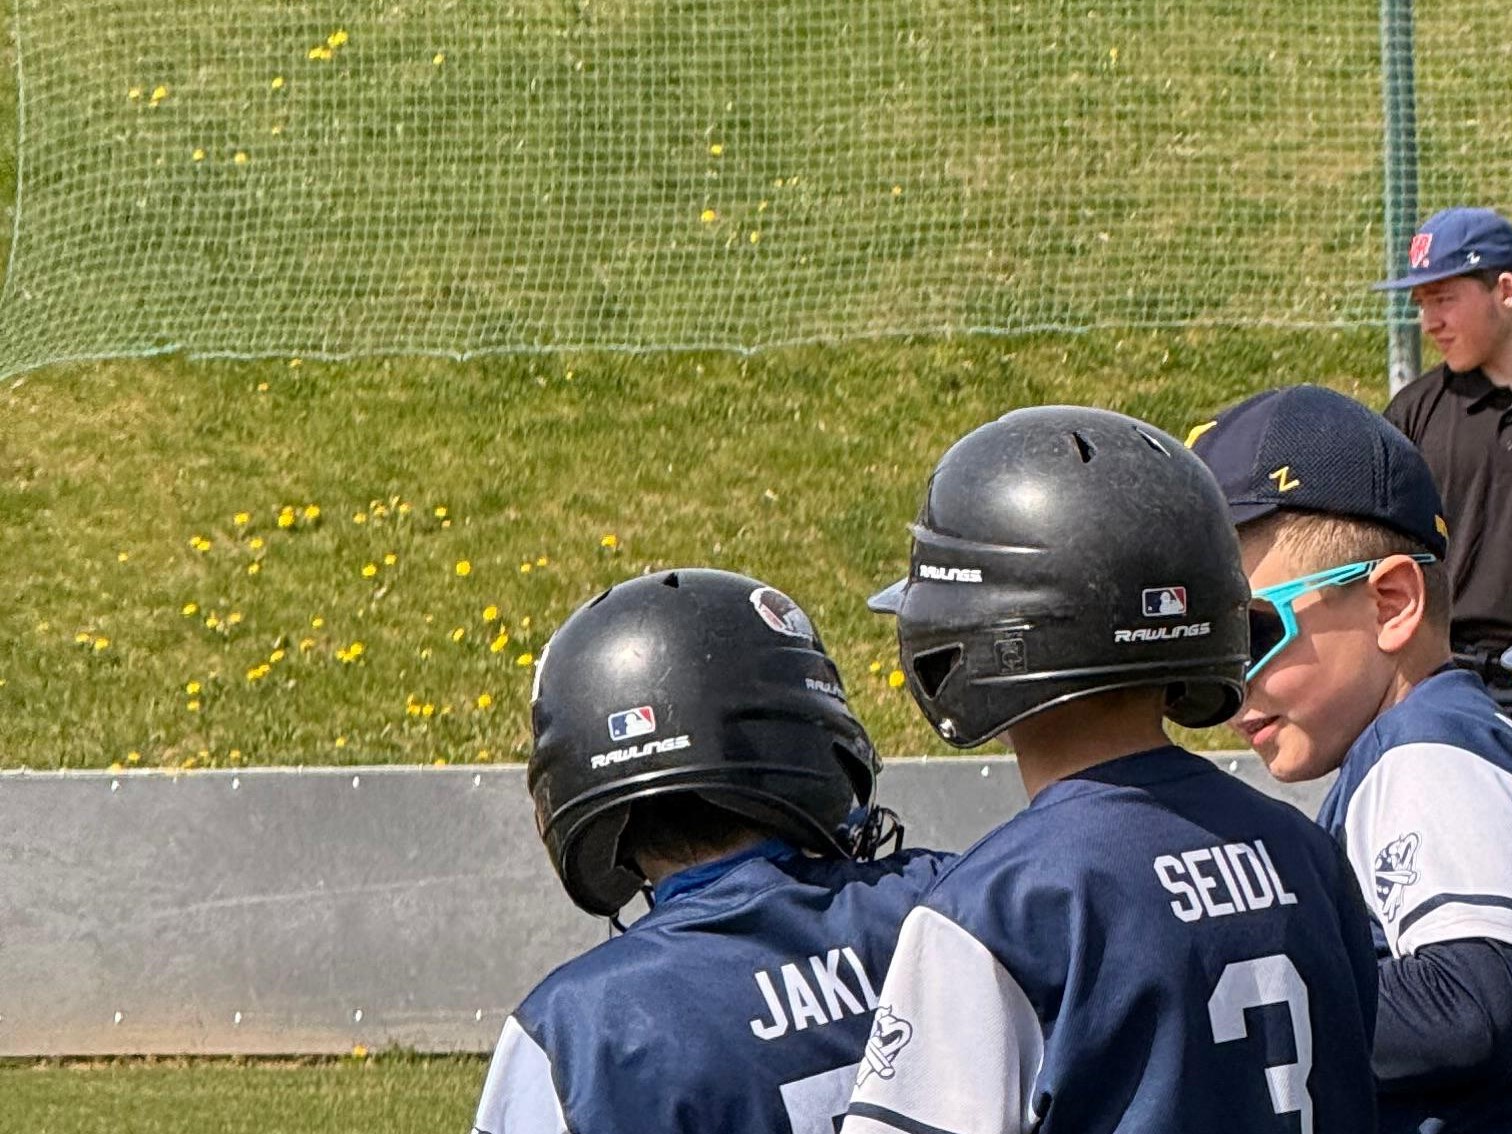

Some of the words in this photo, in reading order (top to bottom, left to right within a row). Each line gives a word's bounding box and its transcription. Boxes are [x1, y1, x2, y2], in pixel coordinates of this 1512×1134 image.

[1113, 621, 1211, 643] RAWLINGS
[590, 734, 692, 770] RAWLINGS
[1153, 839, 1299, 923] SEIDL
